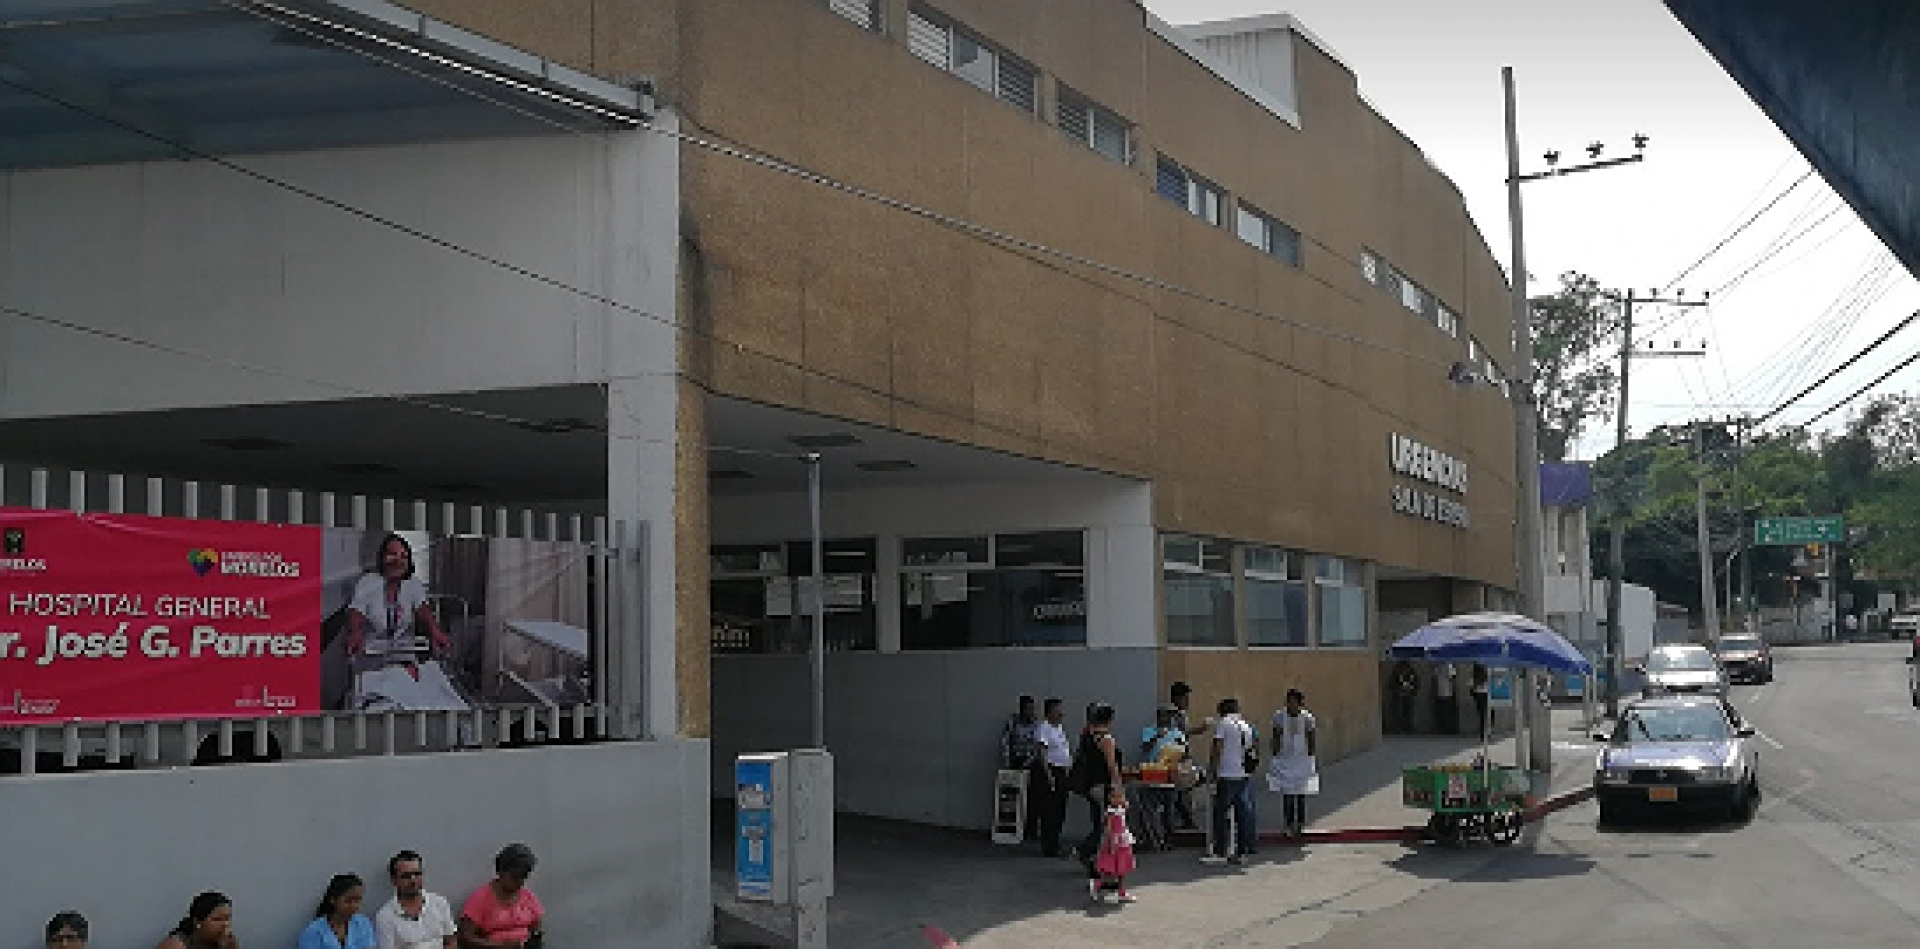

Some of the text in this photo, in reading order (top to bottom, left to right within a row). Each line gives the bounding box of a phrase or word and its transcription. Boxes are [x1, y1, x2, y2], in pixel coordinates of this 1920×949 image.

[0, 558, 46, 570] RELOS
[9, 593, 271, 620] HOSPITAL GENERAL
[35, 621, 129, 666] José
[140, 625, 180, 658] G.
[190, 625, 307, 658] Parres
